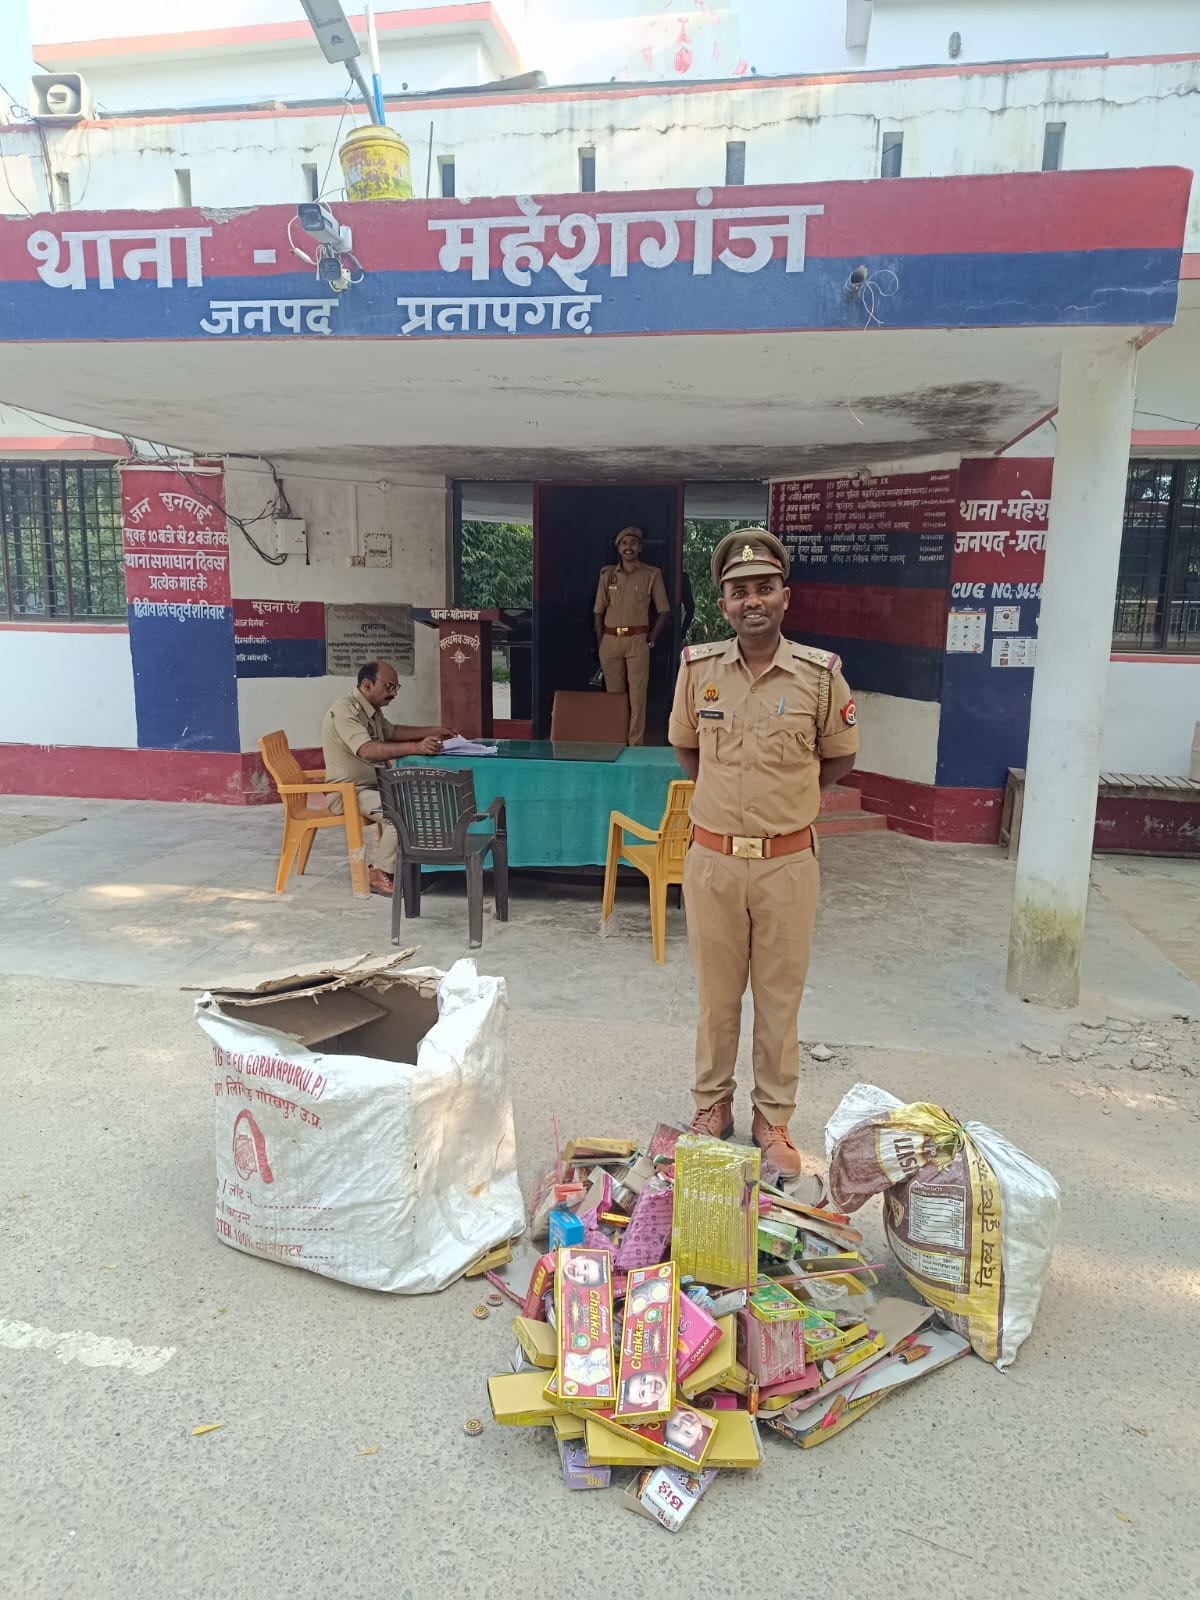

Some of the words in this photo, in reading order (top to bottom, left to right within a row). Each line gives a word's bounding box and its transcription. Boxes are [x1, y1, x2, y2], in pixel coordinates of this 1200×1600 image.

[27, 227, 213, 290] थाना
[428, 187, 825, 292] महेशगंज
[200, 299, 339, 335] जनपद
[397, 295, 602, 335] प्रतापगढ़
[127, 498, 152, 525] जन
[158, 492, 214, 526] सुनवाई
[148, 530, 157, 543] 10
[150, 554, 194, 571] समाधान
[195, 551, 227, 571] दिवस
[148, 574, 178, 591] प्रत्येक
[251, 600, 285, 615] सूचना
[974, 1239, 996, 1289] दिव्य
[588, 1290, 601, 1343] Chakkar
[630, 1318, 645, 1370] Chakkar
[657, 1480, 685, 1513] Big
